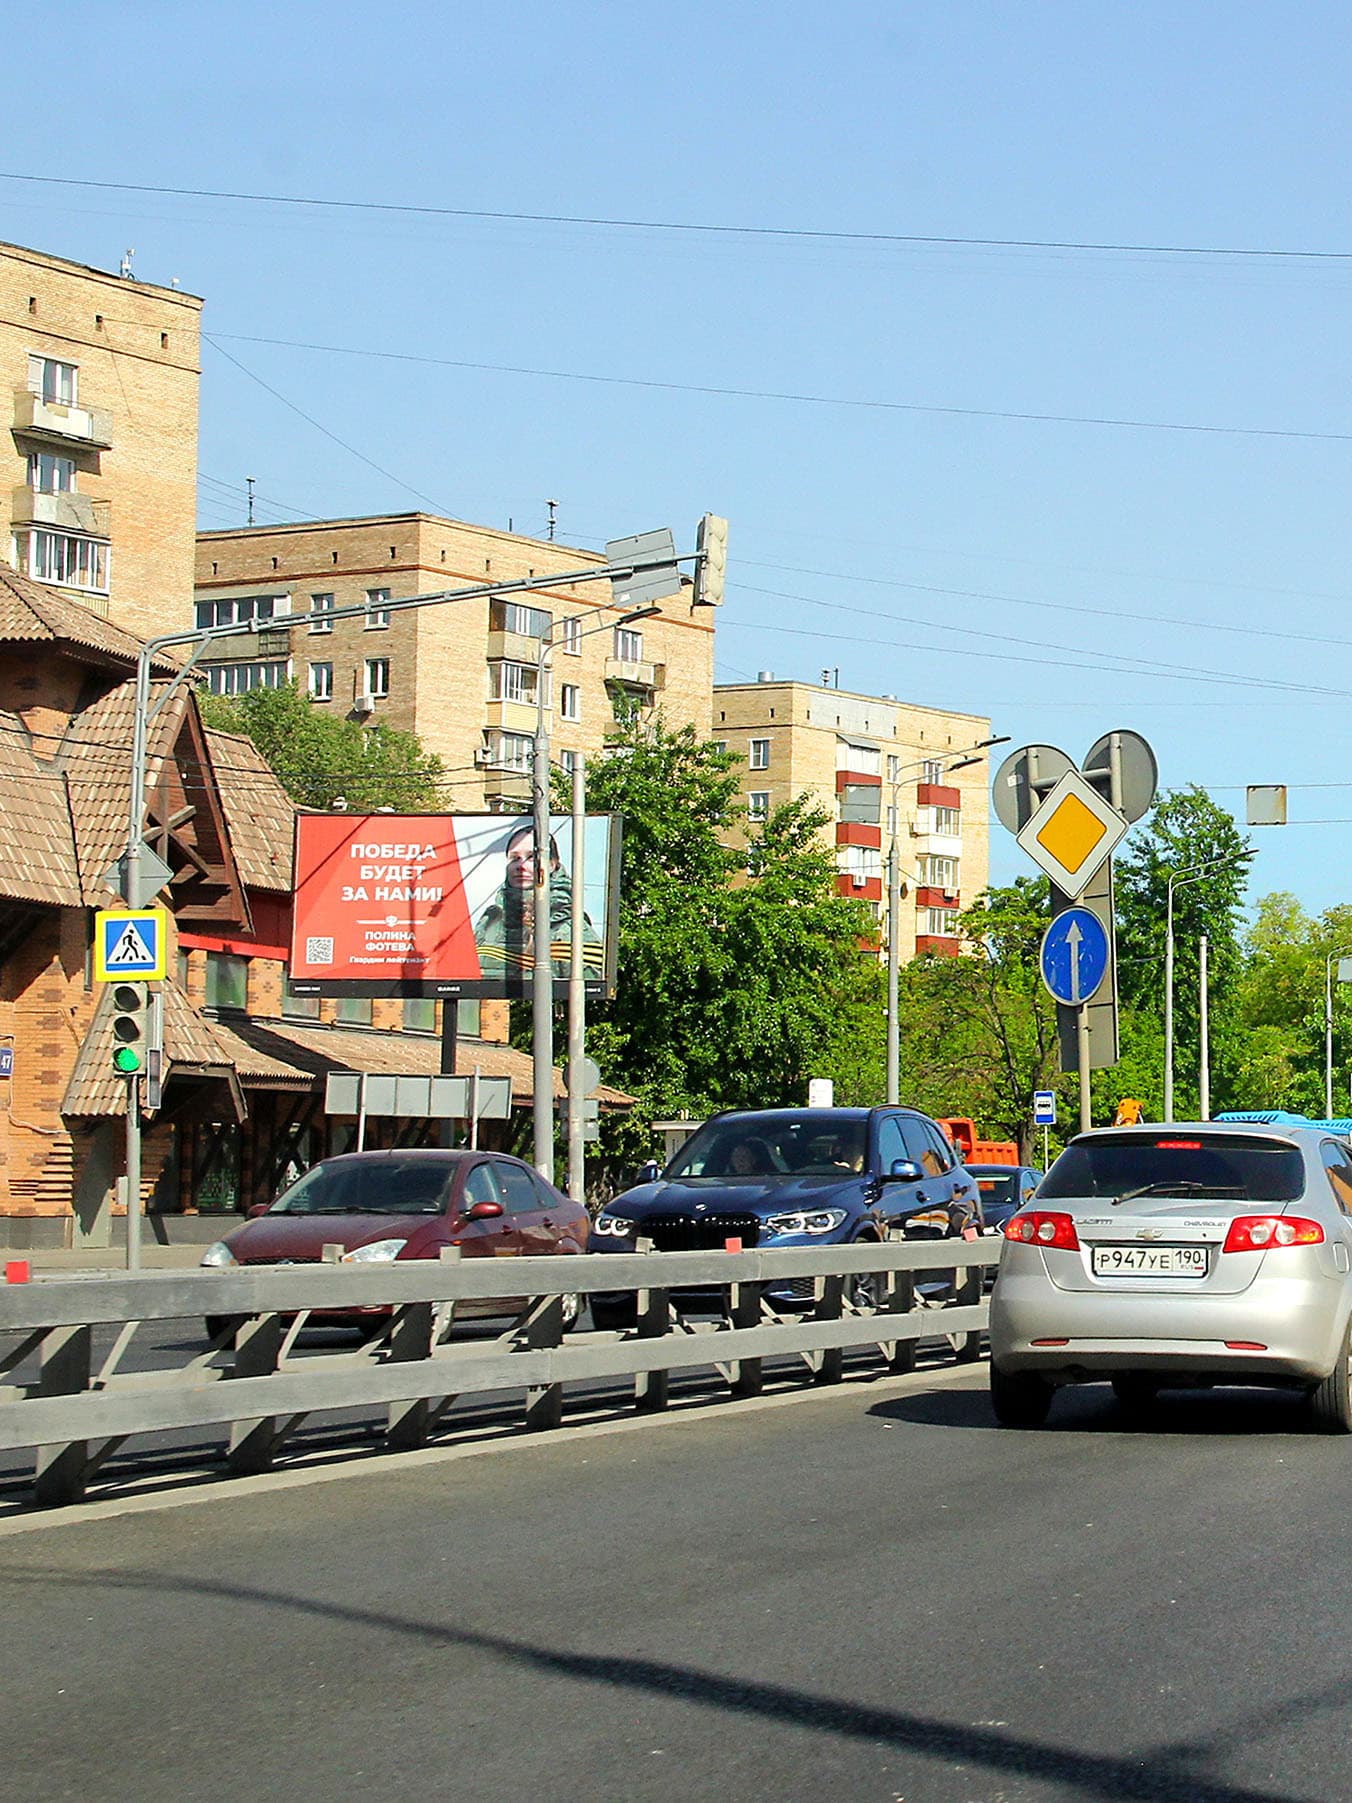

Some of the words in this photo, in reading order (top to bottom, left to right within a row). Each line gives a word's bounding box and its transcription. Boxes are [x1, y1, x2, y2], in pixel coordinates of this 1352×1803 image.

[350, 844, 437, 861] ПОБЕДА
[360, 865, 426, 882] БУДЕТ
[341, 886, 369, 901] ЗА
[375, 887, 443, 901] НАМИ!
[365, 931, 416, 940] ПОЛИНА
[365, 942, 416, 951] ФОТЕВА
[1174, 1250, 1201, 1264] 190
